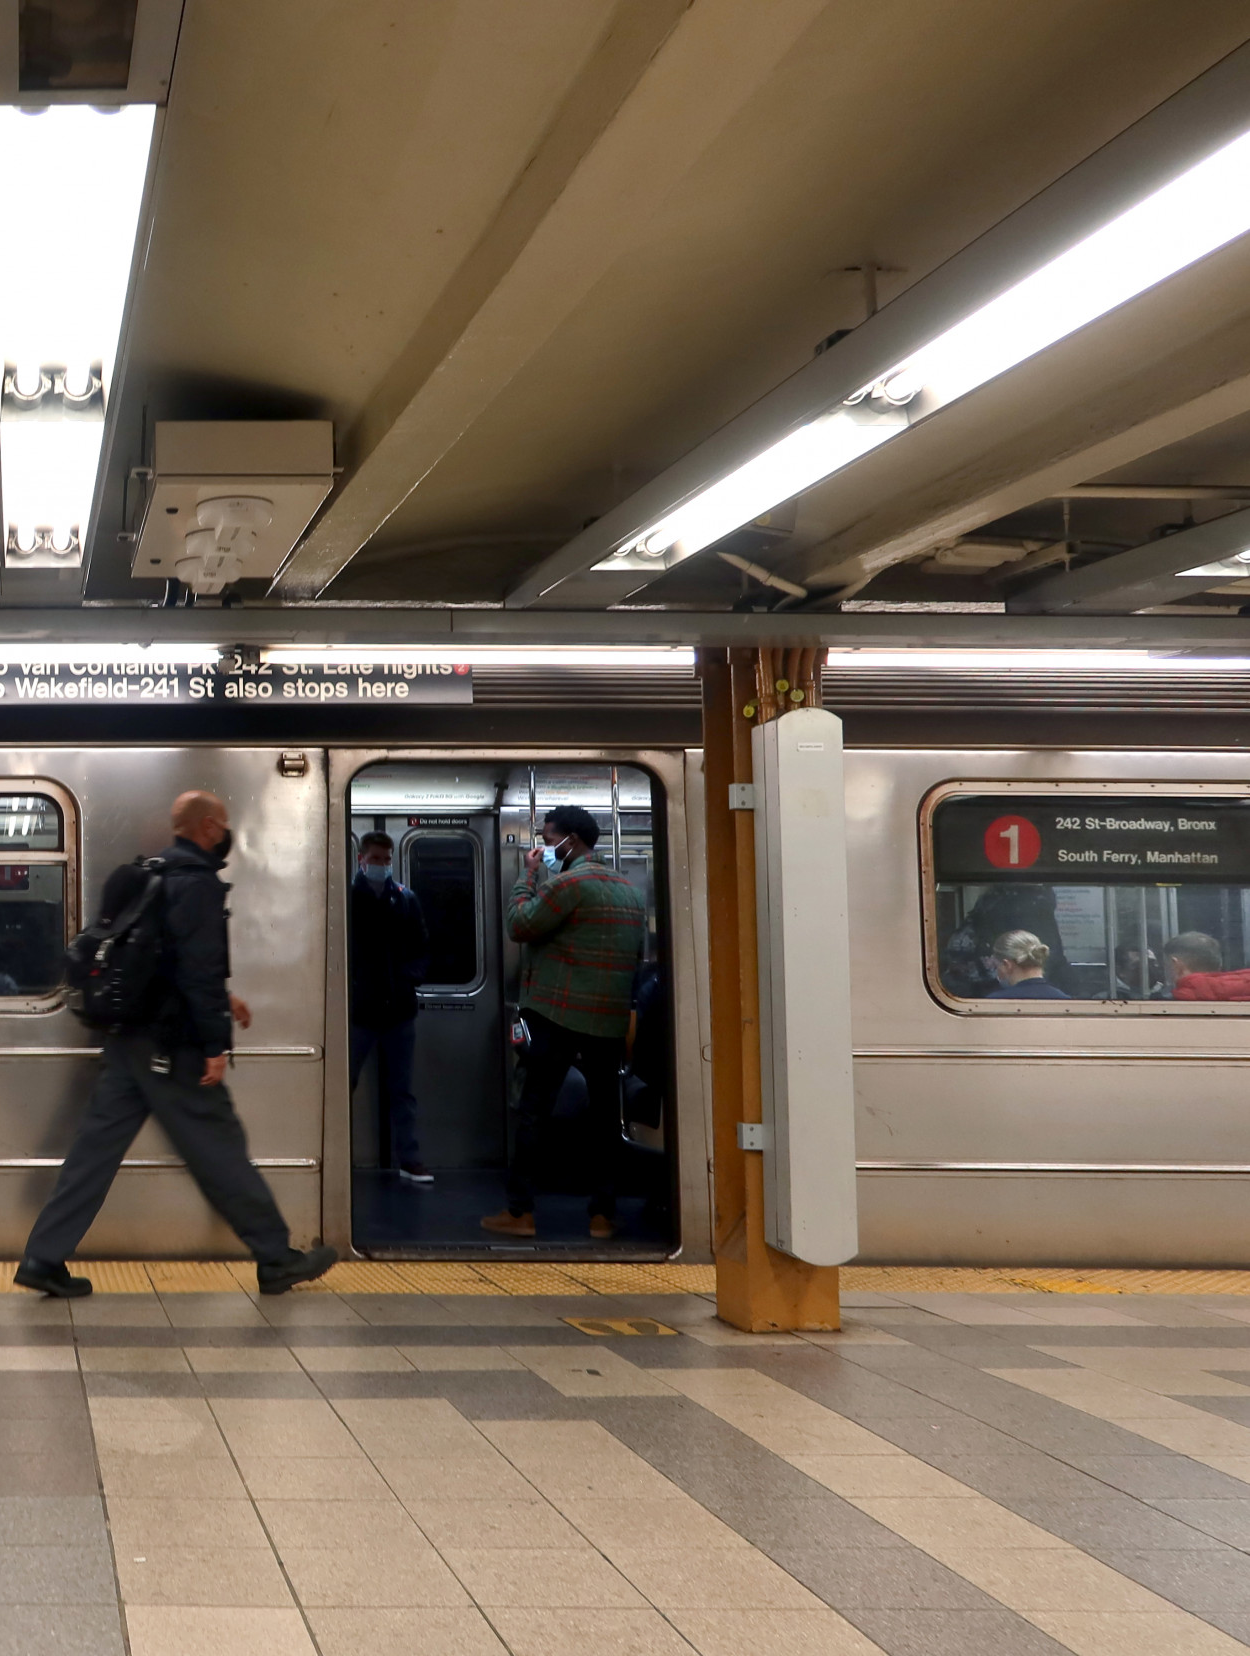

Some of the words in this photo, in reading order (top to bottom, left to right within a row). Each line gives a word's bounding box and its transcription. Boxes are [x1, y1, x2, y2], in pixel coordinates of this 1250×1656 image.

[15, 676, 180, 699] Wakefield-241
[188, 676, 215, 698] St
[224, 677, 273, 698] also
[282, 678, 348, 702] stops
[357, 676, 410, 698] here
[1055, 817, 1082, 830] 242
[1084, 817, 1175, 832] St-Broadway,
[1178, 818, 1217, 831] Bronx
[999, 824, 1020, 864] 1
[1057, 849, 1099, 863] South
[1102, 850, 1142, 865] Ferry,
[1146, 851, 1219, 864] Manhattan
